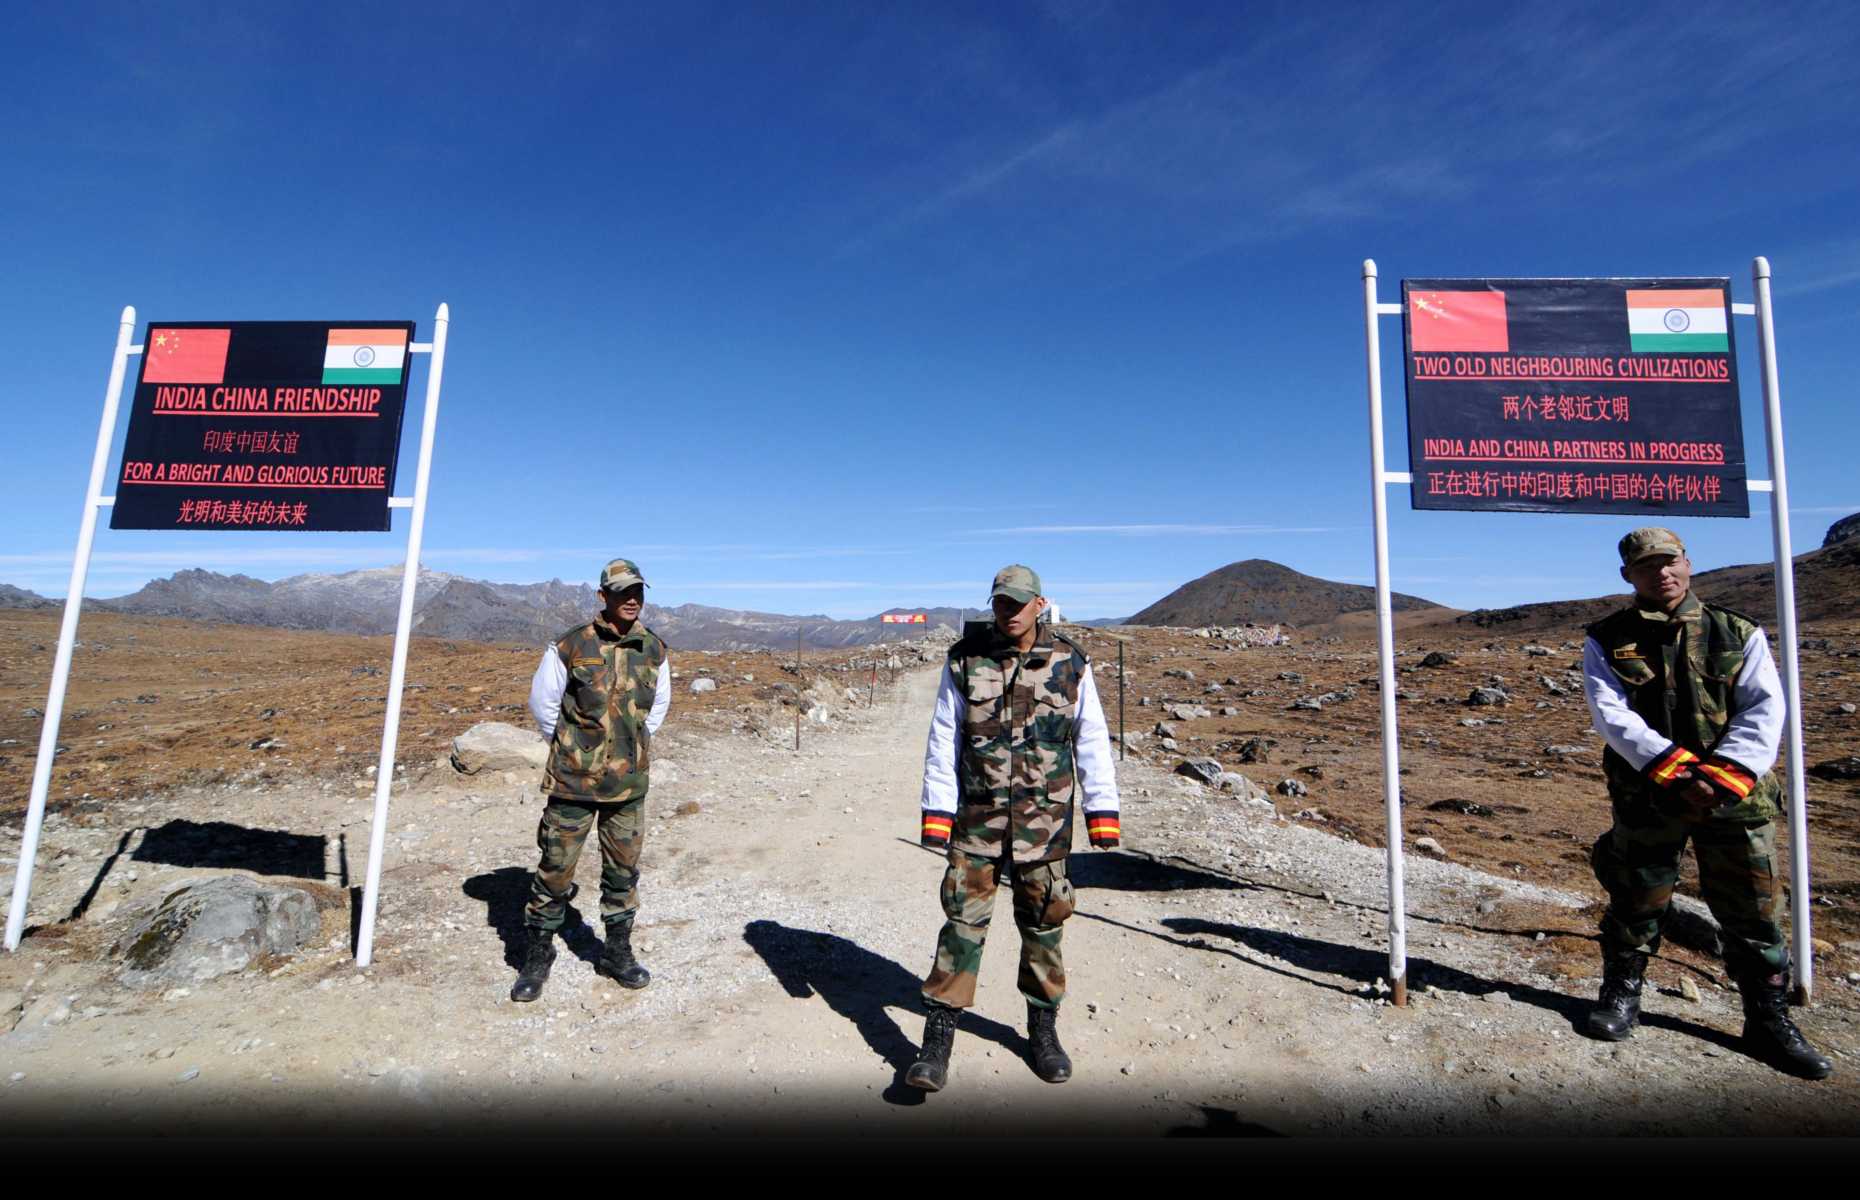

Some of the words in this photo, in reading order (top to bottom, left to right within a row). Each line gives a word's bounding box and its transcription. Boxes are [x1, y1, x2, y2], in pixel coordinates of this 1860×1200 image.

[1414, 356, 1450, 375] TWO
[1455, 357, 1486, 375] OLD
[1490, 357, 1614, 377] NEIGHBOURING
[1618, 358, 1729, 378] CIVILIZATIONS
[155, 386, 206, 410] INDIA
[212, 387, 269, 411] CHINA
[273, 388, 381, 411] FRIENDSHIP
[1502, 394, 1630, 422] 两个老邻近文明
[203, 429, 300, 453] 印度中国友谊
[1424, 438, 1466, 456] INDIA
[1469, 439, 1501, 457] AND
[1504, 440, 1551, 457] CHINA
[1553, 440, 1627, 459] PARTNERS
[1630, 441, 1646, 459] IN
[1650, 442, 1724, 461] PROGRESS
[124, 462, 153, 480] FOR
[154, 463, 166, 480] A
[168, 463, 222, 481] BRIGHT
[222, 465, 255, 482] AND
[257, 465, 329, 484] GLORIOUS
[331, 466, 386, 484] FUTURE
[1427, 469, 1722, 503] 正在进行中的印度和中国的合作伙伴
[176, 498, 308, 525] 光明和美好的未来
